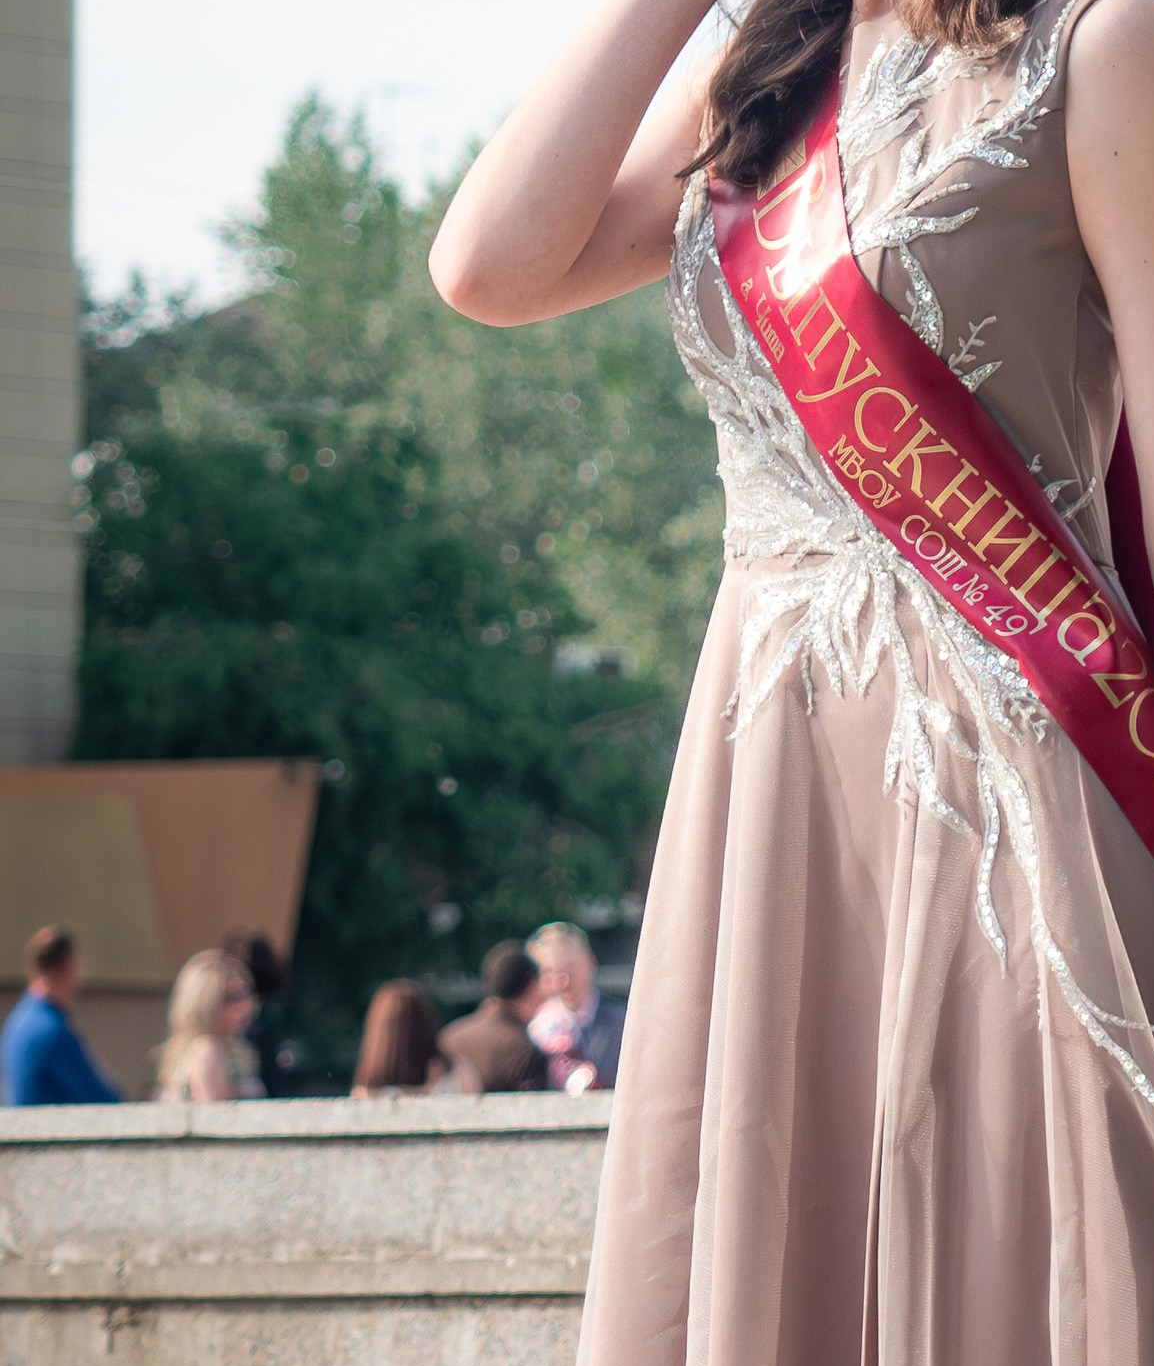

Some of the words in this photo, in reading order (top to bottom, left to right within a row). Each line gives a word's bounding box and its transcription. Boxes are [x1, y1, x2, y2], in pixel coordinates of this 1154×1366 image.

[755, 293, 786, 364] Чита
[828, 434, 901, 508] МБОУ
[901, 515, 967, 581] СОШ
[952, 574, 989, 606] №
[983, 606, 1028, 637] 49
